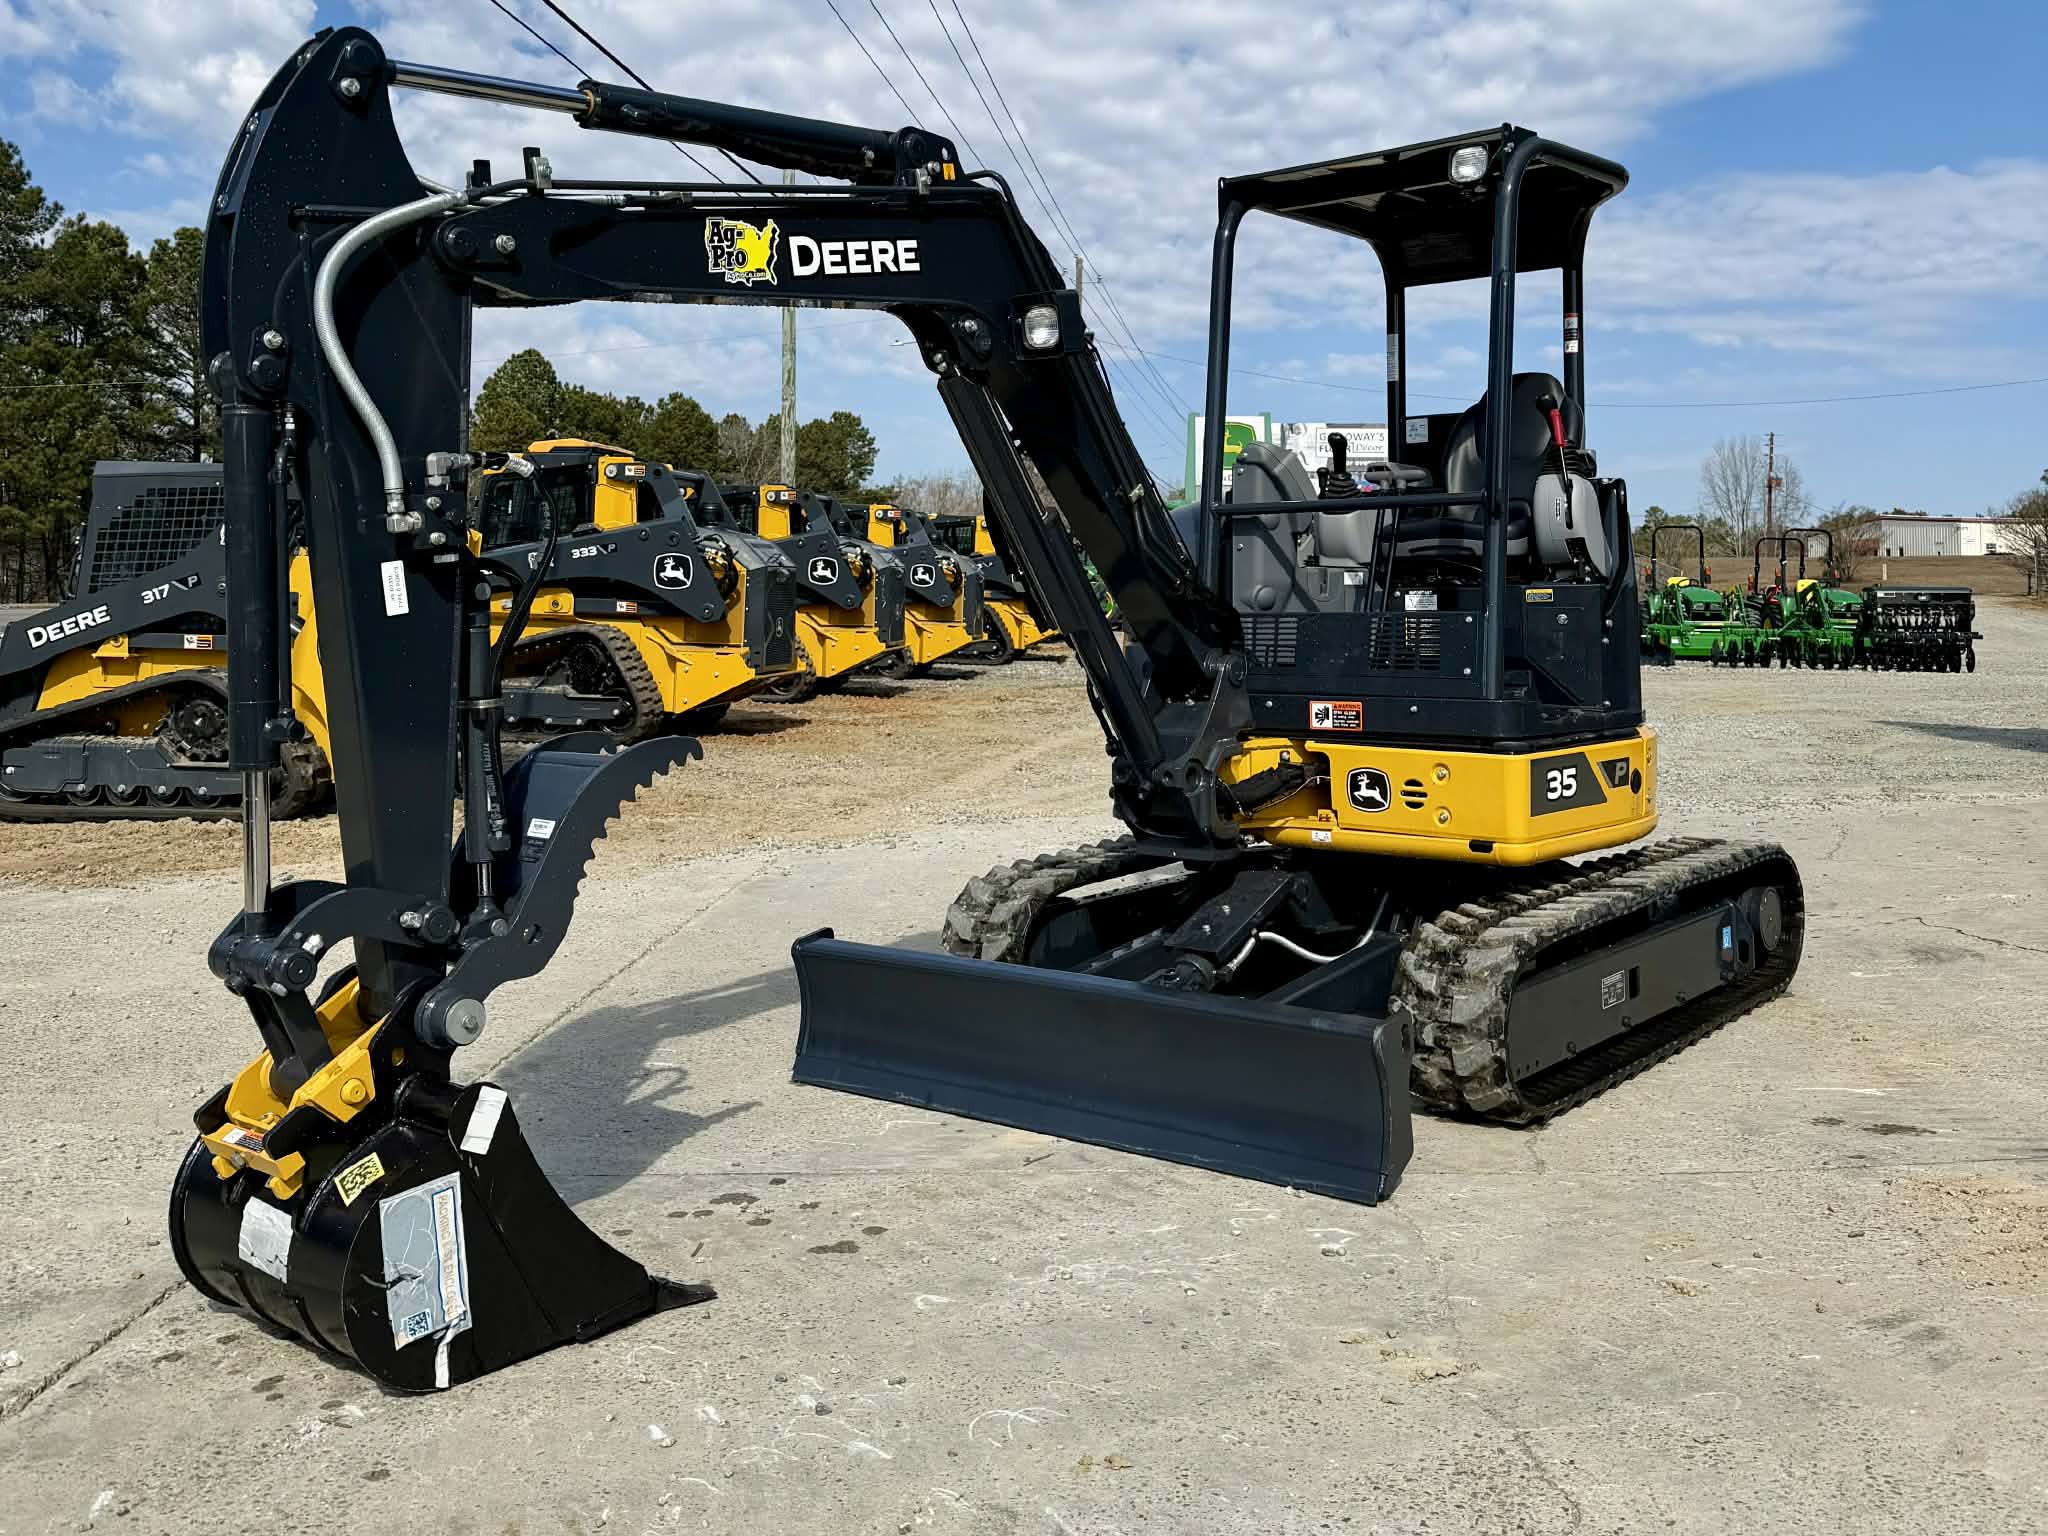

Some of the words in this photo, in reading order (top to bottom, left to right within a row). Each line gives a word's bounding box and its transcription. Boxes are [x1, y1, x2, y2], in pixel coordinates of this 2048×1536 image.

[708, 219, 744, 250] Ag-
[710, 244, 748, 269] Pro
[789, 236, 920, 276] DEERE
[1320, 432, 1384, 441] GOWAY'S
[571, 546, 598, 559] 333
[608, 543, 616, 553] P
[141, 583, 170, 604] 317
[188, 575, 198, 588] P
[27, 605, 111, 648] DEERE
[1547, 767, 1577, 800] 35
[1614, 761, 1627, 785] P
